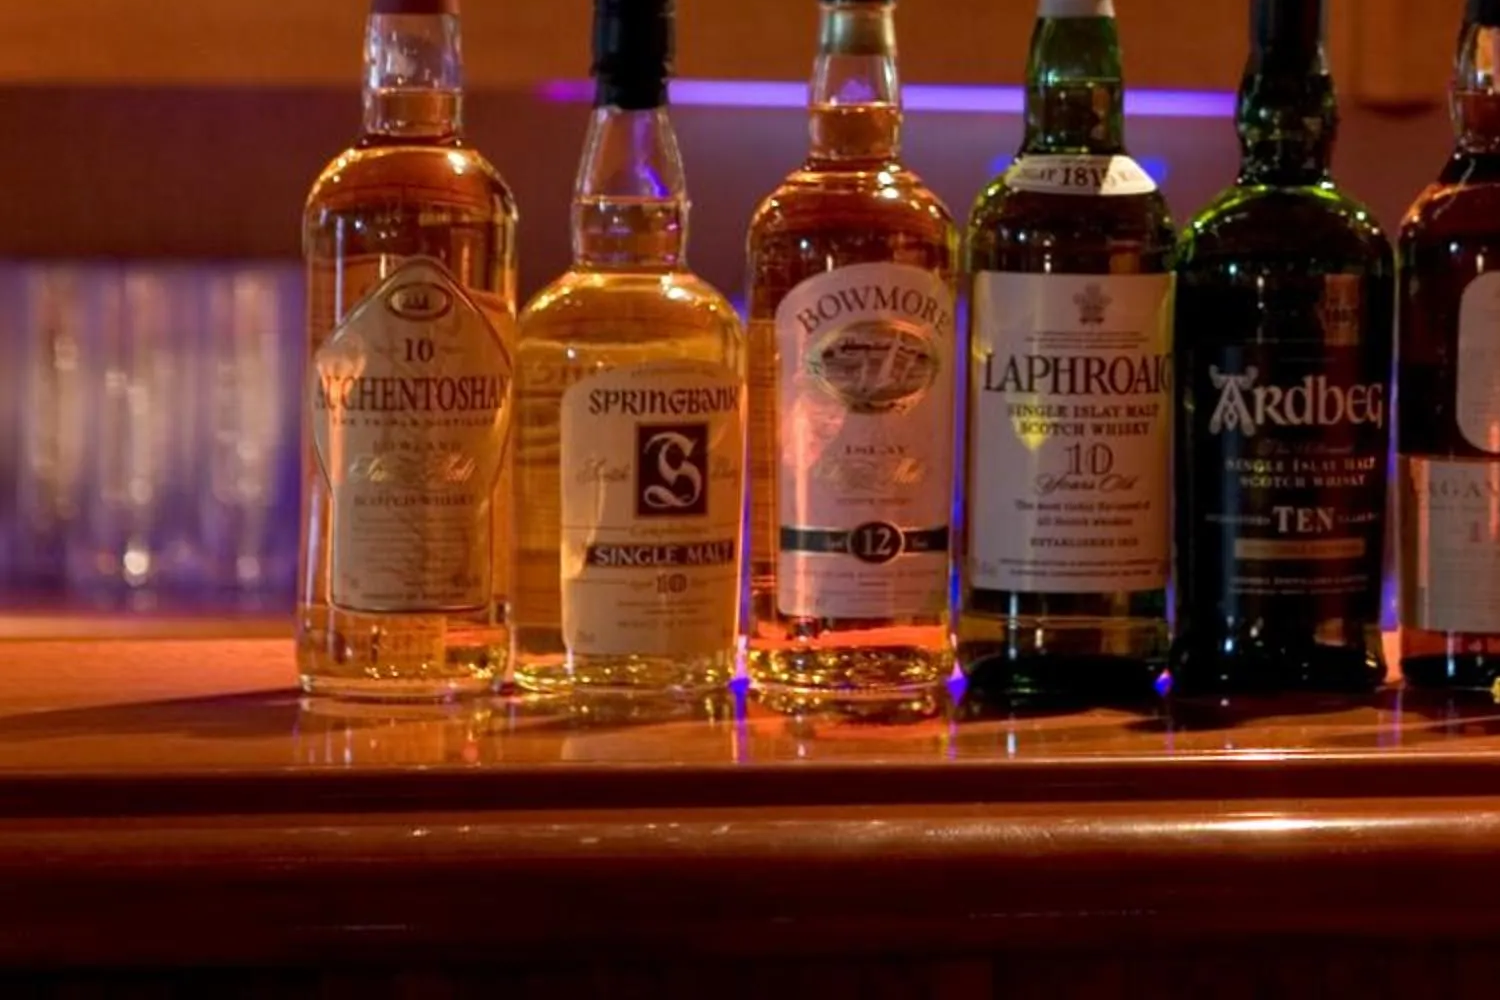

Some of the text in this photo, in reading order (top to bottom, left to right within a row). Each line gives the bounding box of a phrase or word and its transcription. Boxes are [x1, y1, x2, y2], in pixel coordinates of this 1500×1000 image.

[797, 285, 949, 335] BOWMORE
[404, 338, 434, 363] 10
[1073, 404, 1121, 417] ISLAY
[1065, 441, 1114, 476] 10
[1272, 506, 1335, 533] TEN
[863, 528, 893, 555] 12
[595, 546, 679, 566] SINGLE
